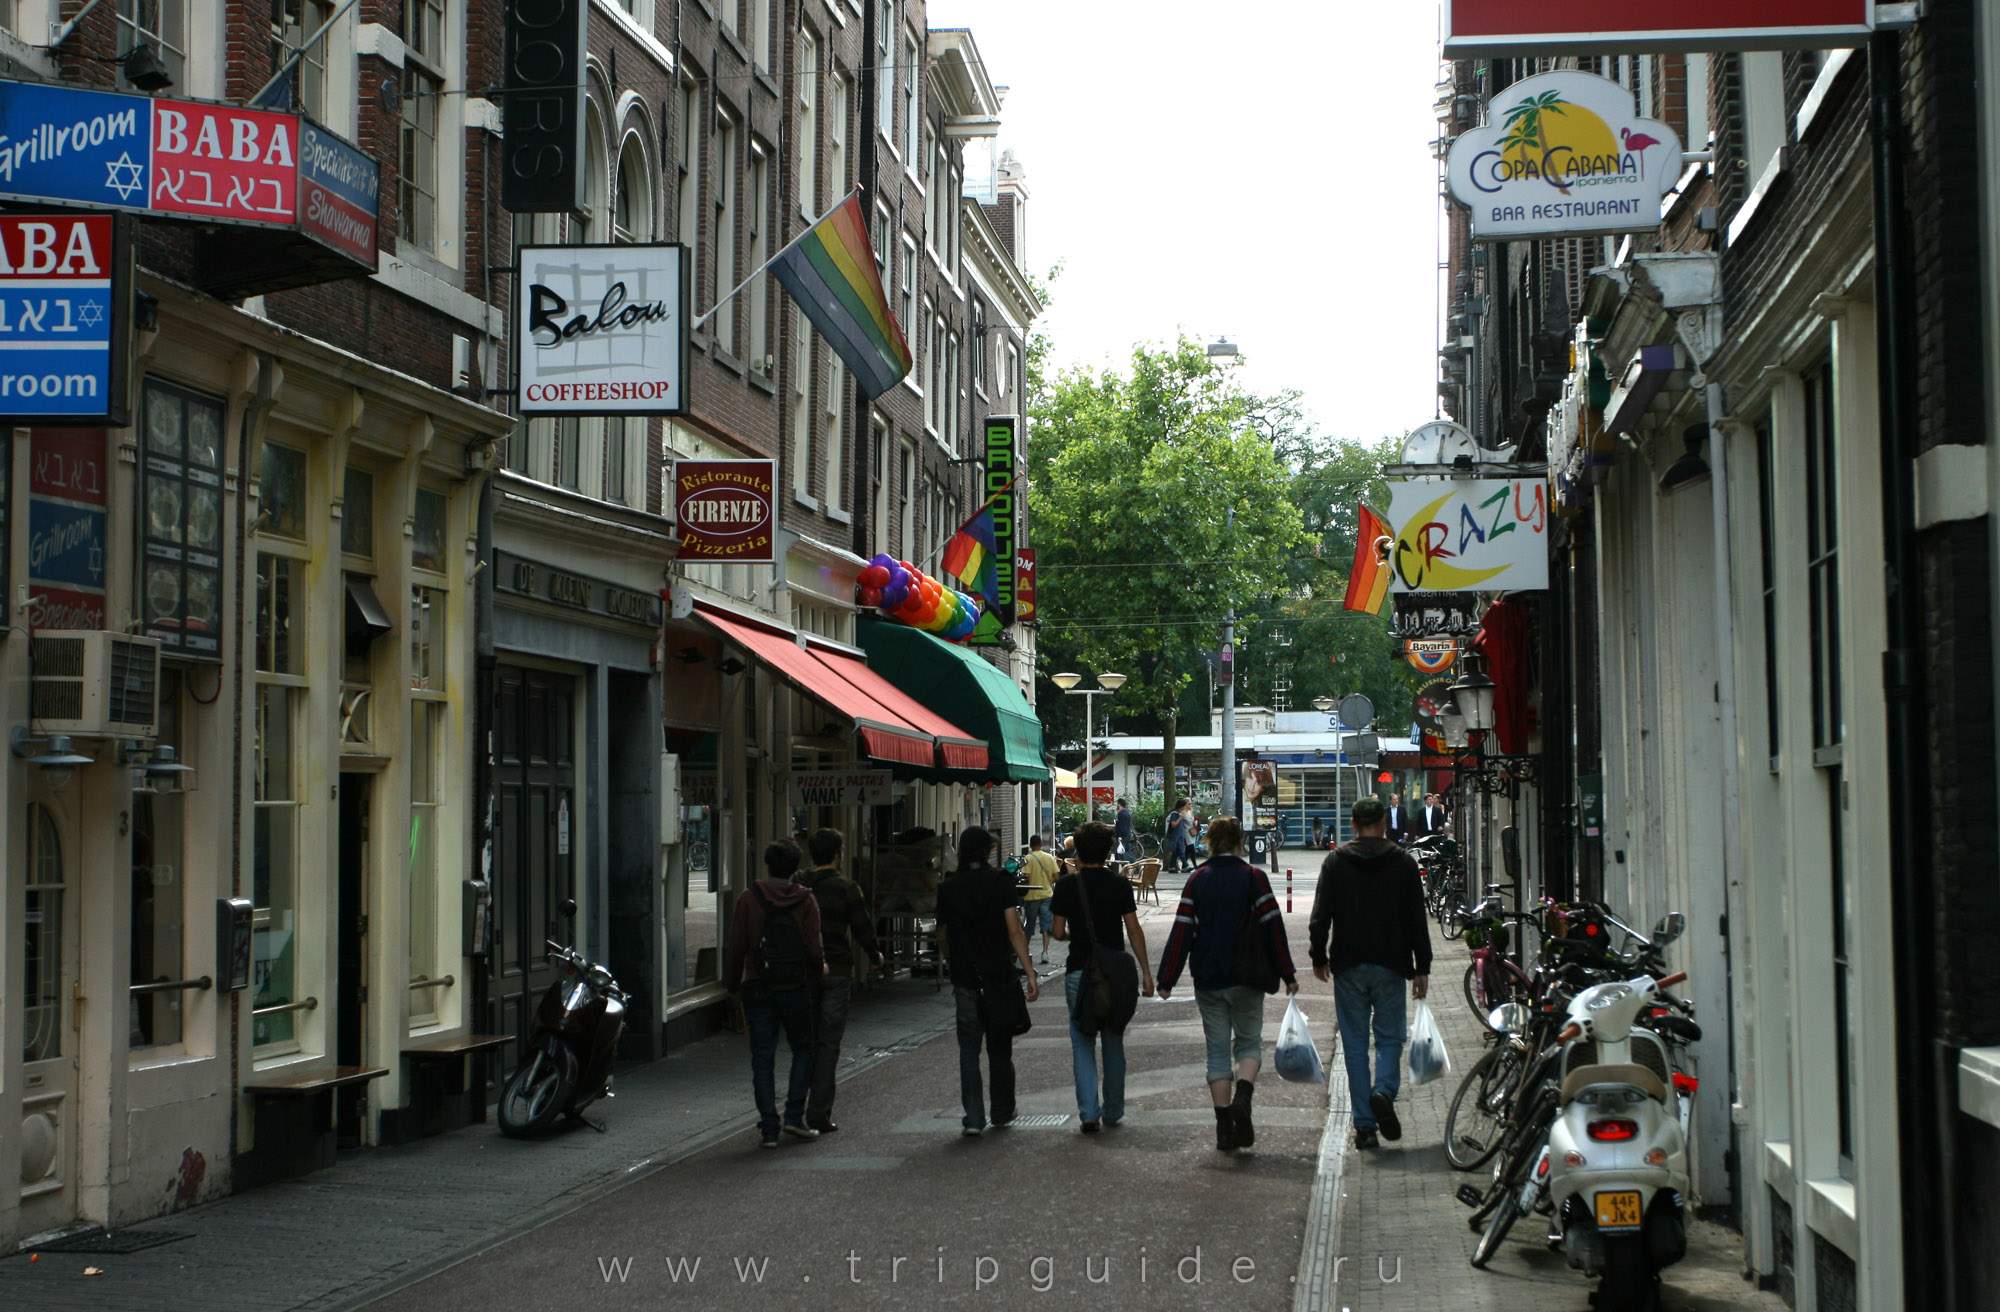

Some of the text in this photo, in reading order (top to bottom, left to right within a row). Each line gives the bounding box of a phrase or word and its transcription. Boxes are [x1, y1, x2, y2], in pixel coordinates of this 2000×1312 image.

[157, 108, 294, 167] BABA
[155, 167, 293, 216] באבא
[1575, 175, 1637, 187] ipanema
[307, 189, 371, 249] Shawarma
[1492, 198, 1641, 221] BAR RESTAURANT
[529, 281, 672, 348] Balou
[2, 374, 97, 397] room
[526, 381, 670, 402] COFFEESHOP
[681, 471, 771, 492] Ristorante
[687, 500, 762, 523] FIRENZE
[31, 514, 93, 574] Grillroom
[681, 532, 769, 556] Pizzeria
[1394, 482, 1546, 591] CRAZY
[30, 594, 104, 630] Specialist
[1412, 642, 1451, 652] Bavaria
[798, 775, 835, 787] PIZZA'S
[847, 775, 885, 787] PASTA'S
[801, 787, 866, 805] VANAF 4
